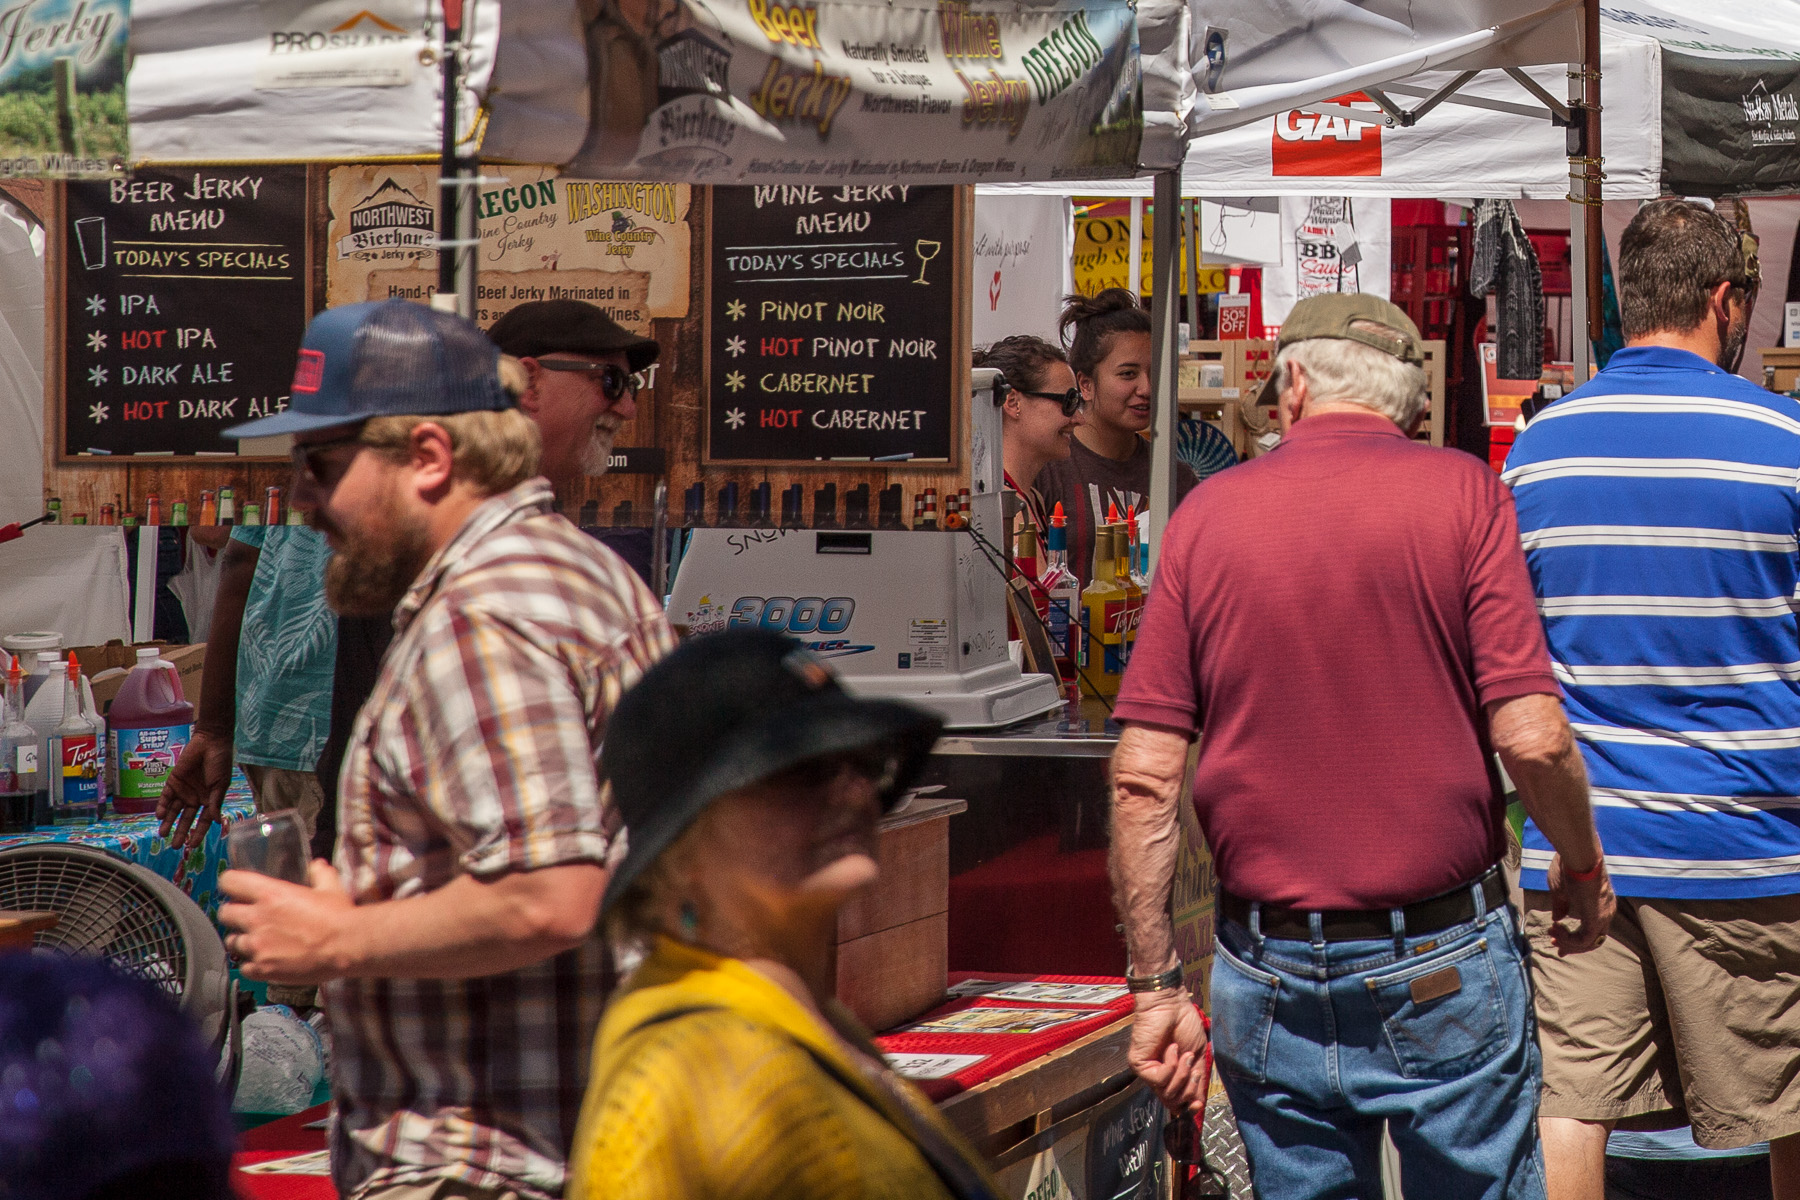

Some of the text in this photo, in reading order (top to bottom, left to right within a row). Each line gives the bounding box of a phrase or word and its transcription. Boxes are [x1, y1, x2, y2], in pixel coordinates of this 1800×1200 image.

[938, 0, 1002, 58] Wine
[841, 40, 929, 65] Naturally Smoked
[1022, 7, 1104, 107] OREGON
[896, 70, 932, 89] Unique
[751, 57, 850, 134] Jerky
[860, 94, 952, 115] Northwest Flavor
[955, 69, 1030, 136] Jerky
[1772, 93, 1799, 121] Metals
[0, 153, 109, 178] gon Wines
[110, 173, 263, 203] BEER JERKY
[754, 184, 910, 208] WINE JERKY
[476, 179, 557, 220] REGON
[566, 183, 677, 224] WASHINGTON
[150, 208, 225, 232] MENU
[353, 205, 432, 227] NORTHWEST
[503, 210, 559, 236] Country
[796, 211, 871, 234] MENU
[1311, 216, 1341, 225] Winnin
[353, 228, 434, 248] Bierhaus
[487, 235, 535, 262] Jerky
[586, 230, 656, 245] Wine Country
[114, 250, 290, 269] TODAY'S SPECIALS
[381, 250, 405, 260] Jerky
[606, 243, 635, 257] Jerky
[1301, 241, 1336, 259] BB
[727, 252, 904, 272] TODAY'S SPECIALS
[120, 294, 160, 315] IPA
[477, 286, 507, 299] Beef
[510, 286, 545, 302] Jerky
[550, 286, 614, 300] Marinated
[618, 286, 630, 300] in
[1221, 320, 1246, 333] OFF
[1222, 309, 1246, 322] 50%
[122, 328, 217, 349] HOT IPA
[760, 338, 804, 356] HOT
[122, 363, 233, 385] DARK ALE
[760, 373, 875, 394] CABERNET
[123, 401, 169, 421] HOT
[178, 398, 238, 419] DARK
[760, 409, 928, 431] HOT CABERNET
[728, 596, 856, 634] 3000
[140, 735, 168, 743] Super
[67, 743, 98, 767] Tora
[79, 782, 97, 790] LEMO
[1103, 1118, 1125, 1156] WINE
